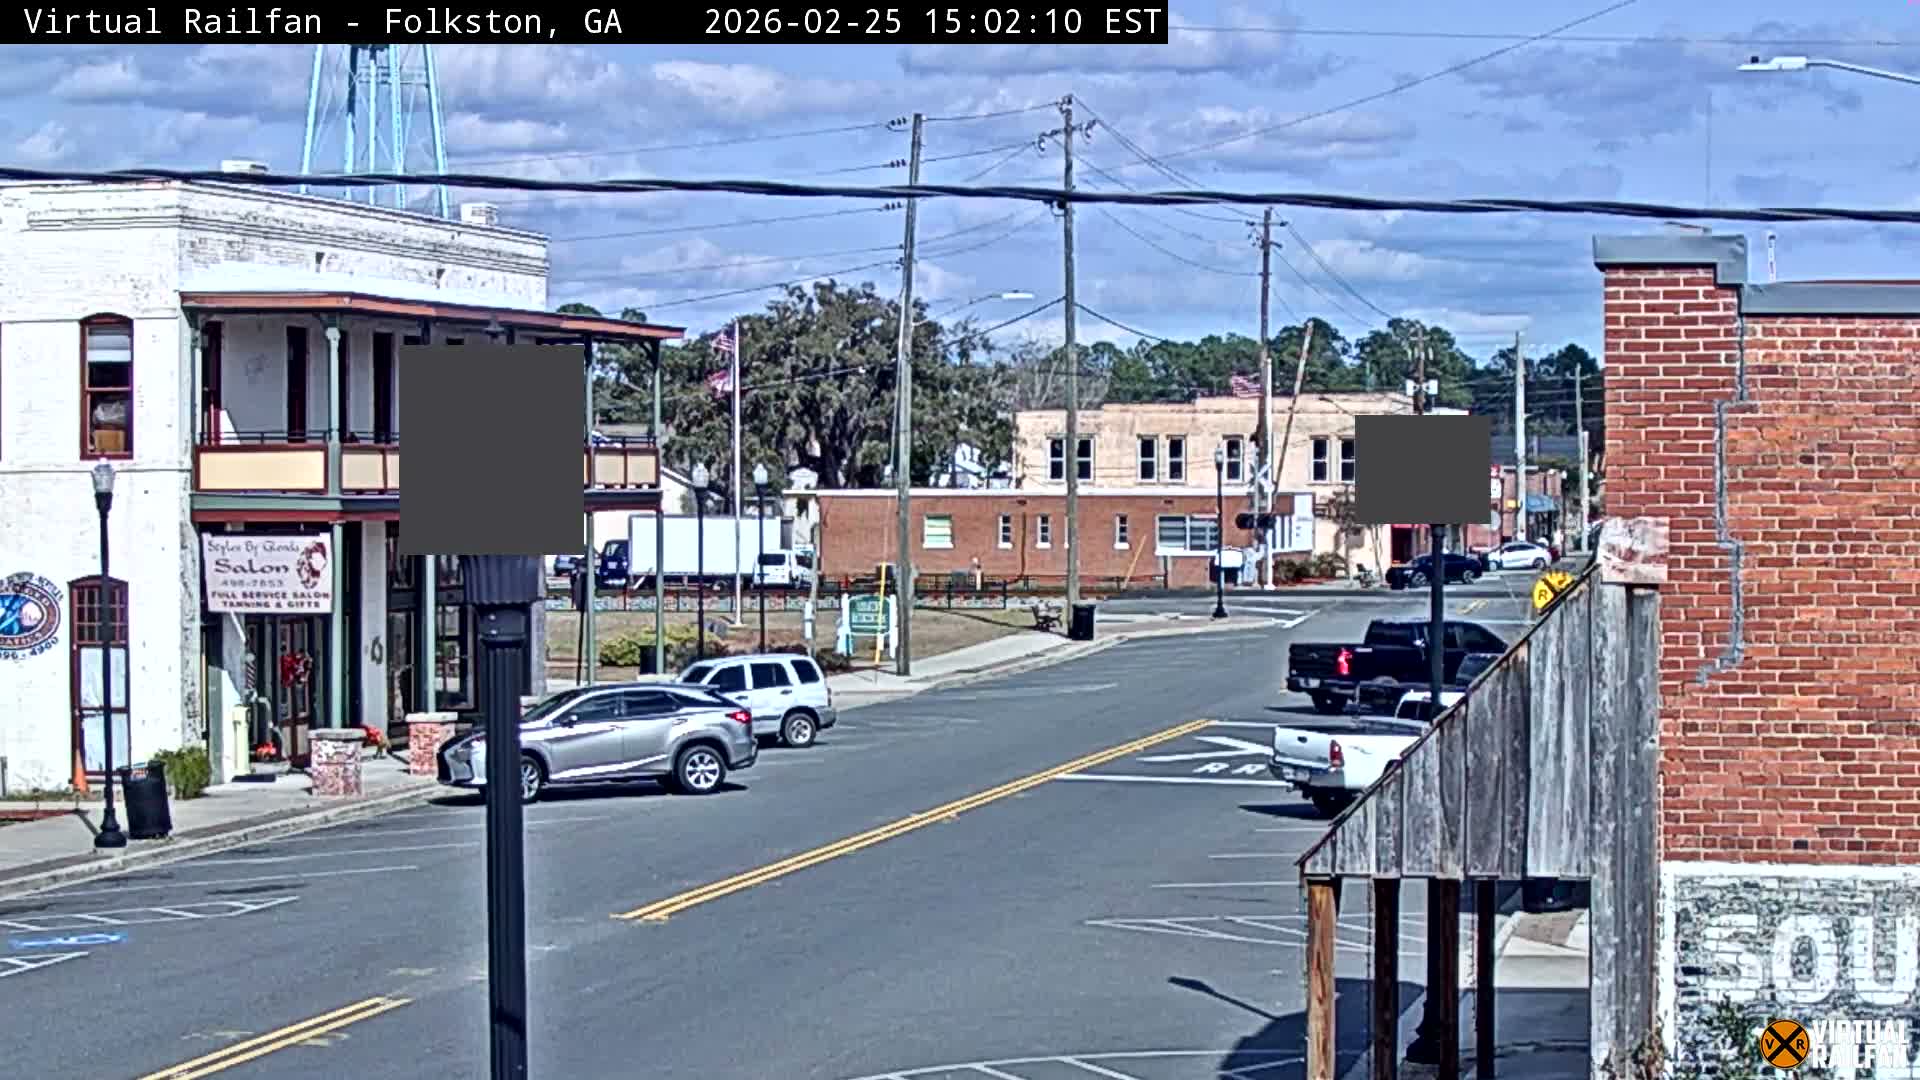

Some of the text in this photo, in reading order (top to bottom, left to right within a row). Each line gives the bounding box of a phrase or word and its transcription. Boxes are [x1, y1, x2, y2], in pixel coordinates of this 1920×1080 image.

[214, 559, 290, 574] Salon
[211, 591, 330, 599] FULL SERVICE SALON
[1538, 589, 1548, 601] R
[221, 601, 271, 609] TANNING
